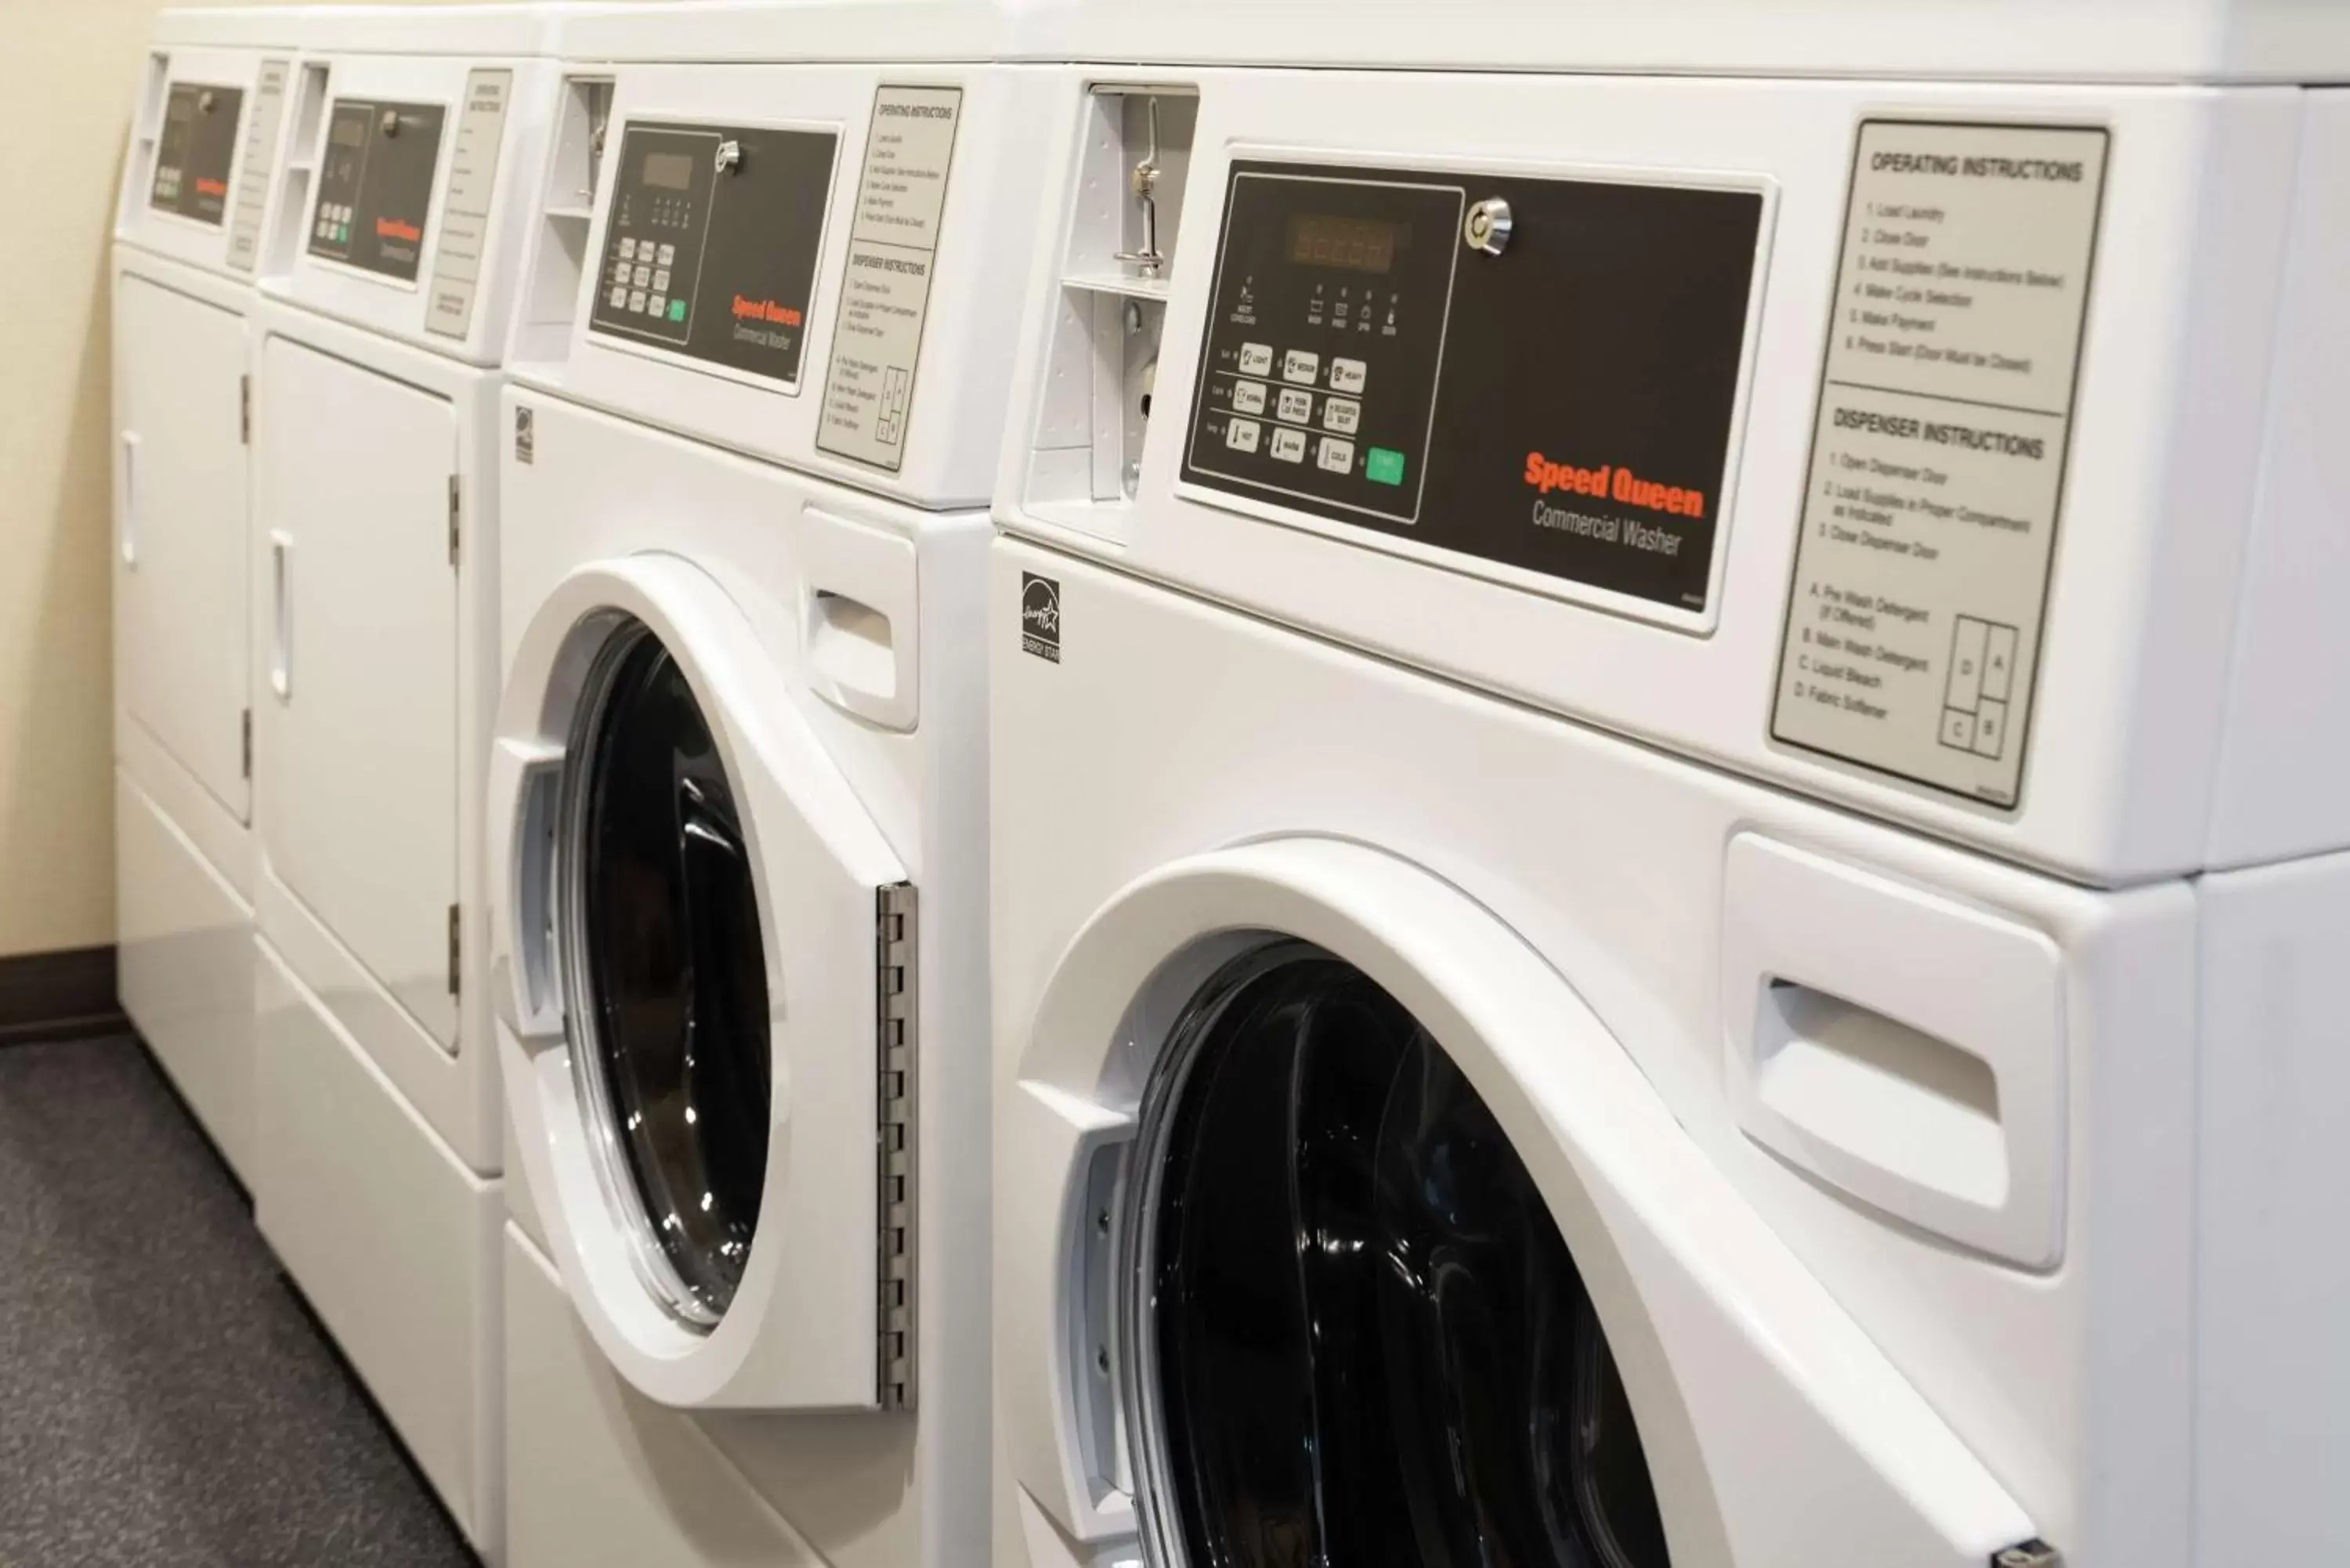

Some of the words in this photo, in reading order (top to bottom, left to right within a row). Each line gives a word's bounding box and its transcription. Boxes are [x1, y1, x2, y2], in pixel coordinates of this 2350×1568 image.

[1871, 151, 1958, 175] OPERATING
[1962, 156, 2083, 182] INSTRUCTIONS
[1833, 407, 1920, 439] DISPENSER
[1922, 421, 2044, 461] INSTRUCTIONS
[1524, 450, 1611, 498] Speed
[1612, 467, 1705, 518] Queen
[1532, 499, 1620, 543] Commercial
[1622, 518, 1683, 557] Washer
